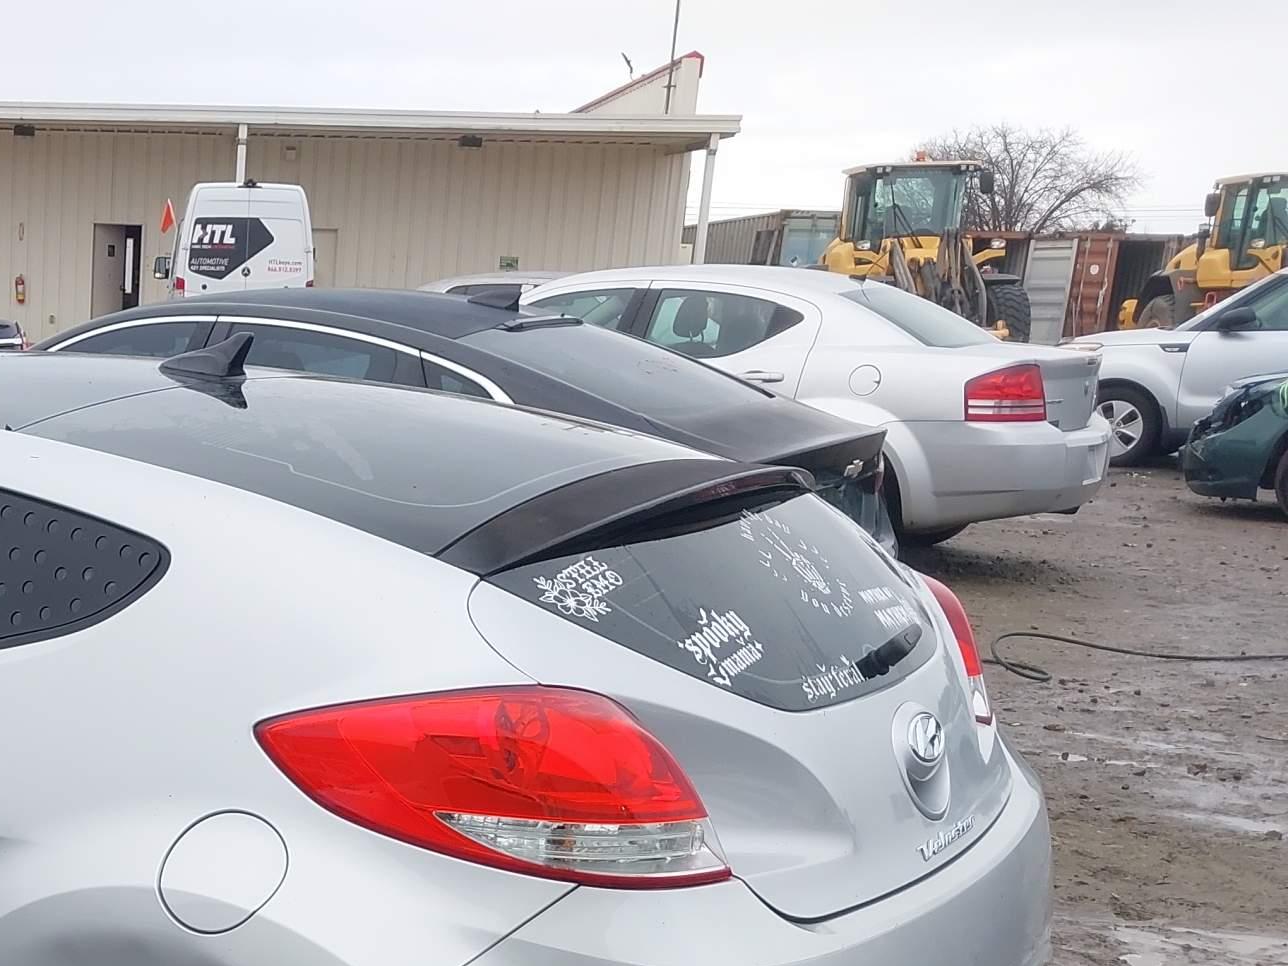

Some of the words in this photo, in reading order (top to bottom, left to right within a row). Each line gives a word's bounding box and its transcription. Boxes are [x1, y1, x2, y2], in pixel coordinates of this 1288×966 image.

[192, 224, 236, 244] HTL
[190, 257, 230, 266] AUTOMOTIVE
[582, 570, 623, 598] EMO
[684, 609, 752, 664] spooky
[721, 643, 762, 676] mama
[801, 672, 837, 704] stay
[916, 815, 976, 862] Veloster
